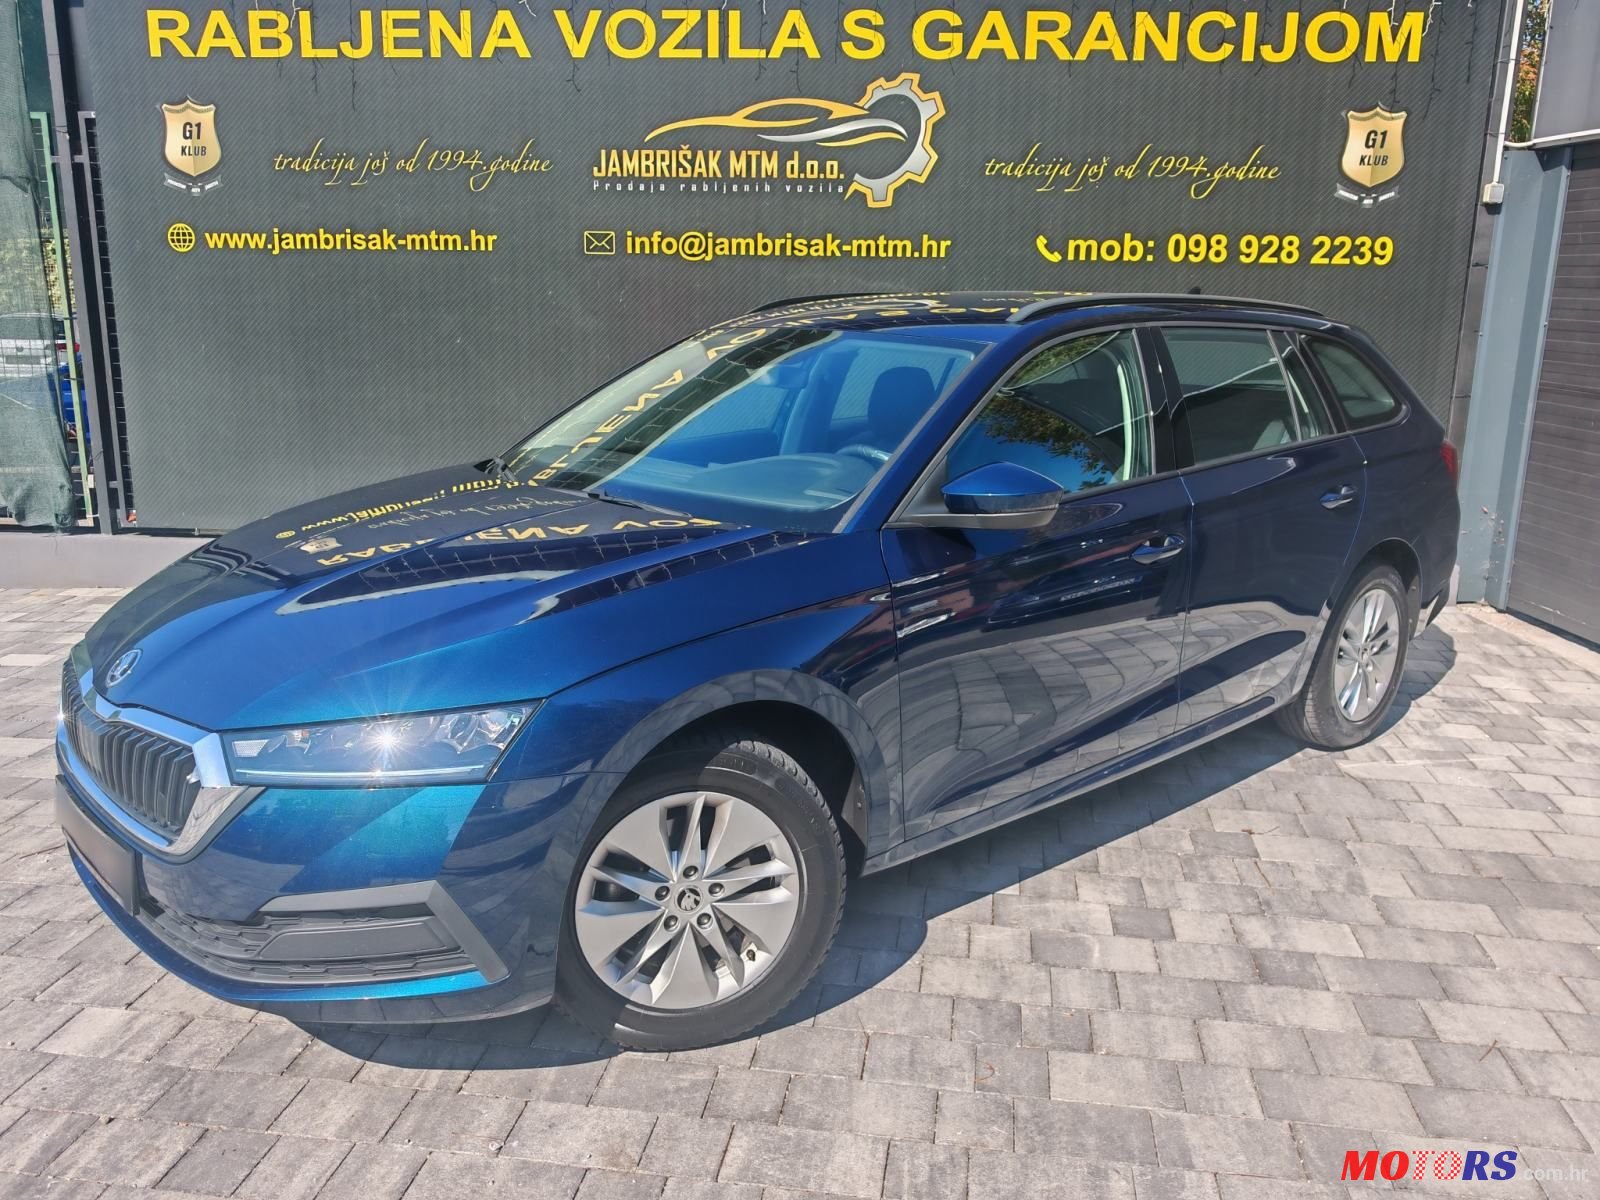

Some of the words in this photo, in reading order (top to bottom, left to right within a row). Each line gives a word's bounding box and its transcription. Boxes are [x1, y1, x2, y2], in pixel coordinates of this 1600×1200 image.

[146, 9, 532, 59] RABLJENA
[553, 9, 821, 59] VOZILA
[841, 9, 886, 59] S
[912, 9, 1425, 63] GARANCIJOM
[182, 122, 202, 141] G1
[1364, 129, 1388, 149] G1
[180, 145, 207, 157] KLUB
[273, 137, 356, 187] tradicija
[351, 150, 391, 187] još
[396, 137, 429, 173] od
[593, 145, 722, 178] JAMBRIŠAK
[729, 150, 778, 178] MTM
[786, 151, 845, 179] d.o.o.
[1358, 153, 1389, 167] KLUB
[984, 142, 1076, 192] tradicija
[1064, 155, 1110, 192] još
[1115, 143, 1153, 179] od
[593, 180, 666, 194] Prodaja
[680, 181, 770, 195] rabljenih
[785, 183, 845, 194] vozila
[205, 227, 498, 255] www.jambrisak-mtm.hr
[626, 231, 951, 261] info@jambrisak-mtm.hr
[1066, 232, 1155, 262] mob:
[1167, 233, 1227, 263] 098
[1239, 234, 1300, 264] 928
[1310, 235, 1394, 265] 2239
